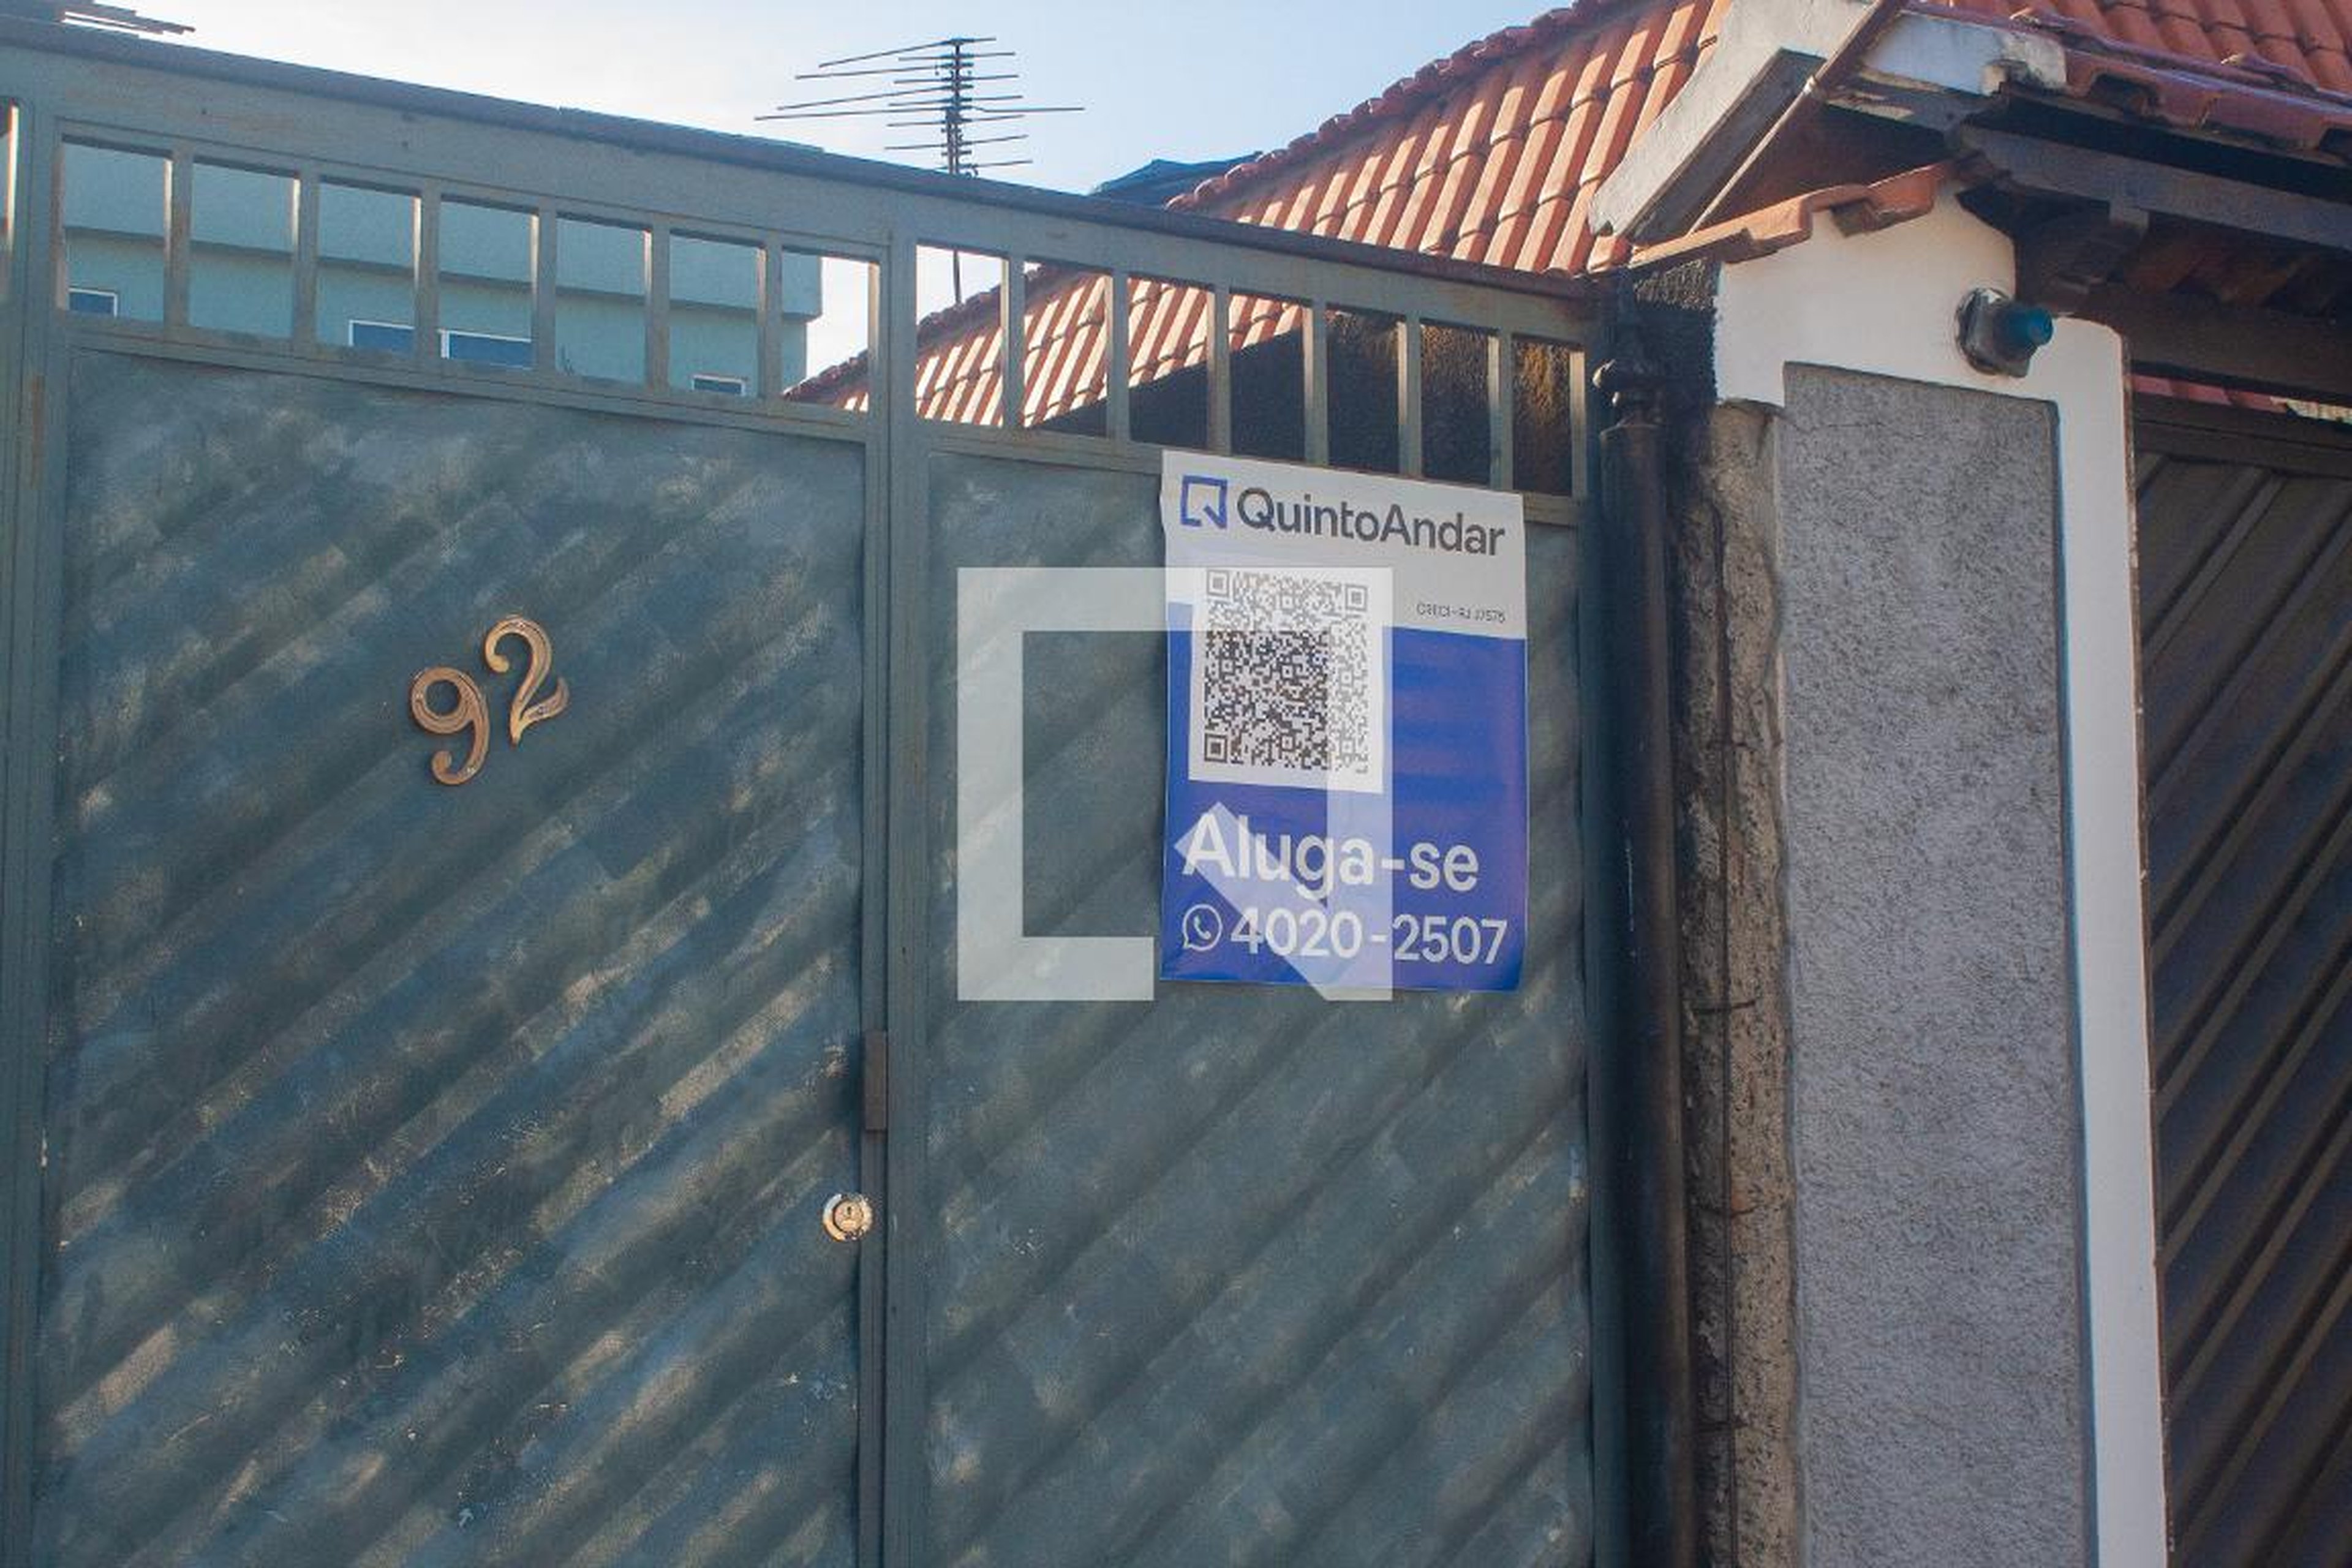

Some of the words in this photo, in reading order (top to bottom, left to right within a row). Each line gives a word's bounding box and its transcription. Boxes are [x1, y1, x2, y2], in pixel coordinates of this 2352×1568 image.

[1236, 488, 1506, 555] QuintoAndar
[411, 615, 569, 785] 92
[1182, 813, 1479, 900] Aluga-se
[1230, 907, 1508, 965] 4020-2507
